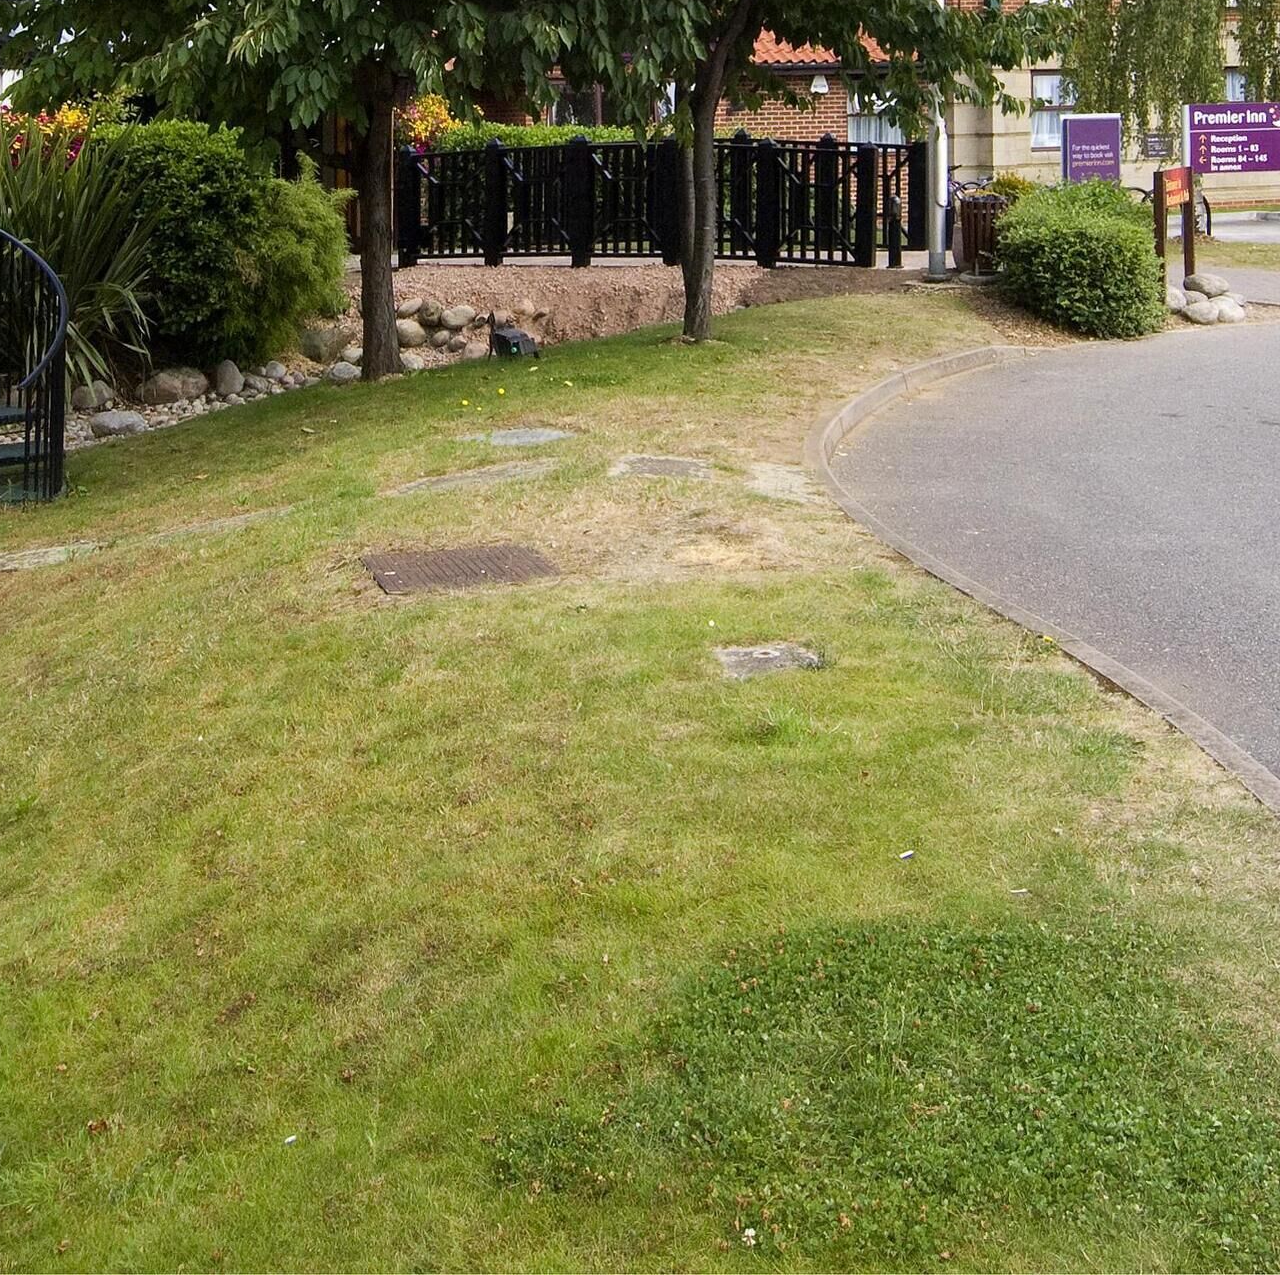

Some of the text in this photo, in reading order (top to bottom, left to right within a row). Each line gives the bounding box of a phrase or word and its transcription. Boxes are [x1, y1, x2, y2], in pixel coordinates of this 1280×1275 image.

[1193, 110, 1267, 125] Premier Inn
[1210, 134, 1248, 144] Reception
[1210, 155, 1236, 163] Rooms
